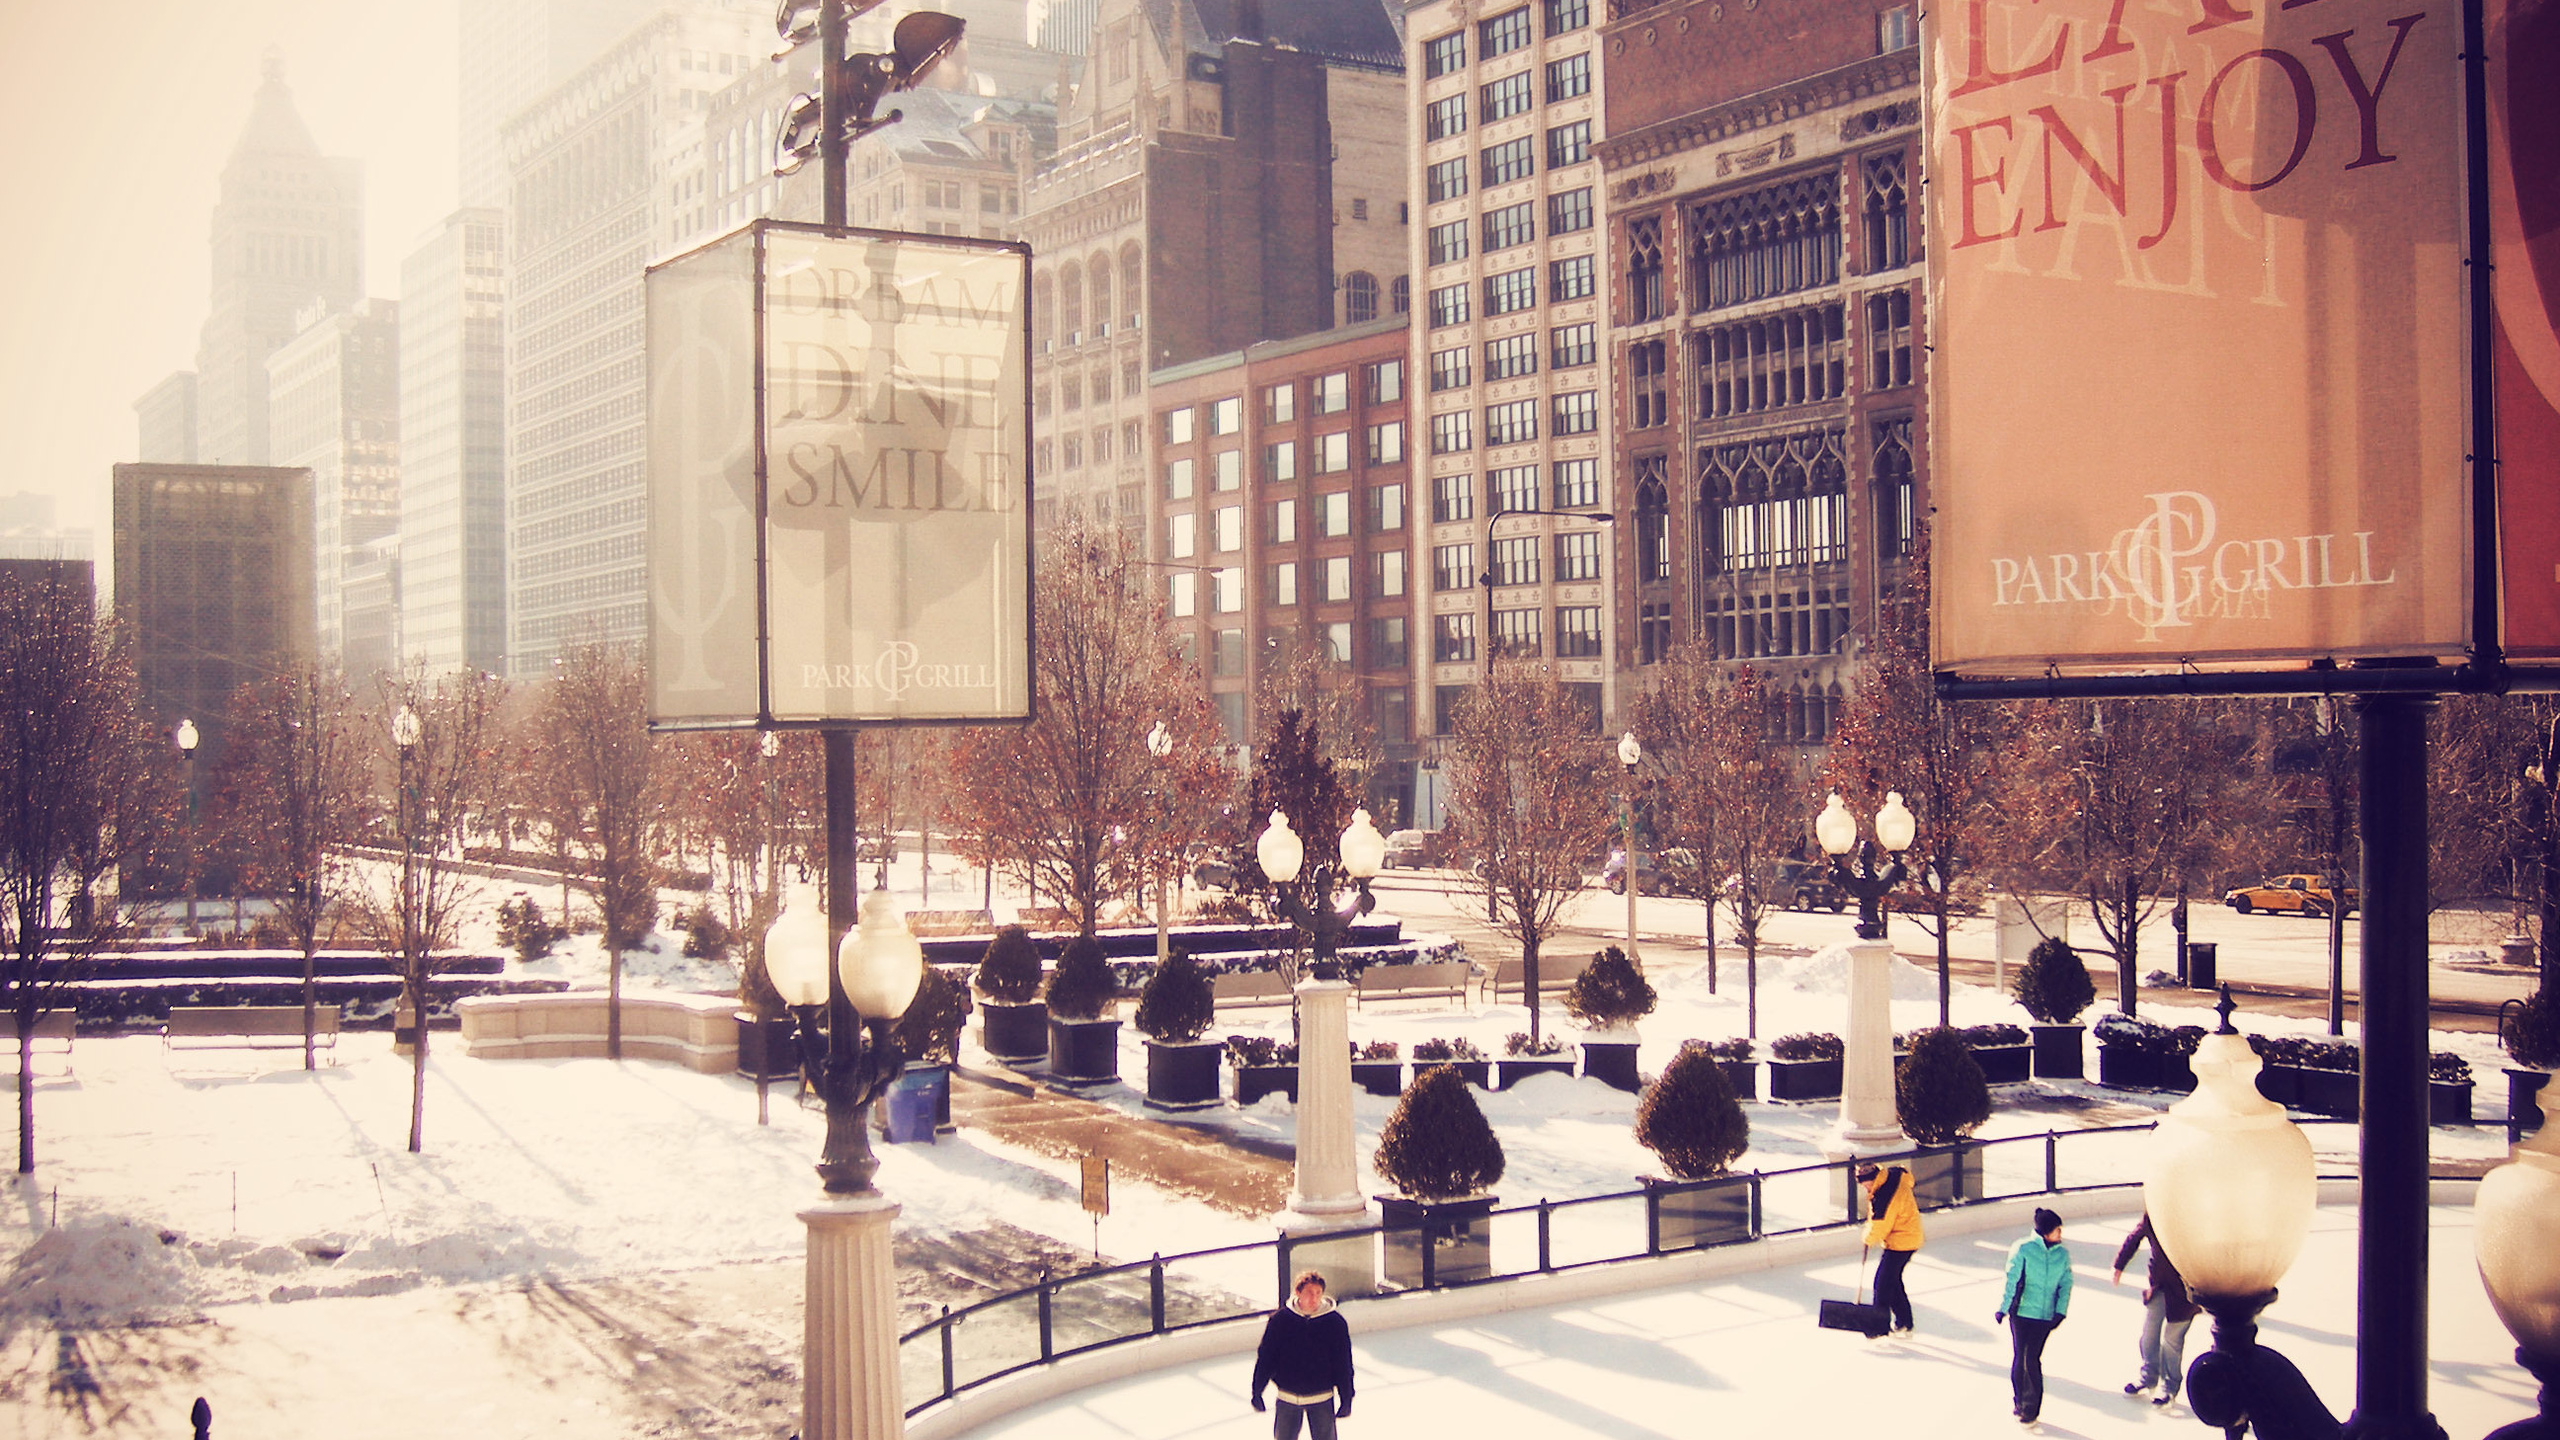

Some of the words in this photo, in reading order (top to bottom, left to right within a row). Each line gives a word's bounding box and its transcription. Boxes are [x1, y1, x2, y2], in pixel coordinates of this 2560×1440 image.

[1951, 12, 2425, 250] ENJOY
[781, 266, 1009, 331] DREAM
[774, 340, 1009, 431] DINE
[784, 442, 1016, 513] SMILE
[1990, 550, 2126, 606] PARK
[2212, 531, 2396, 594] GRILL
[802, 664, 874, 689] PARK
[914, 664, 997, 689] GRILL
